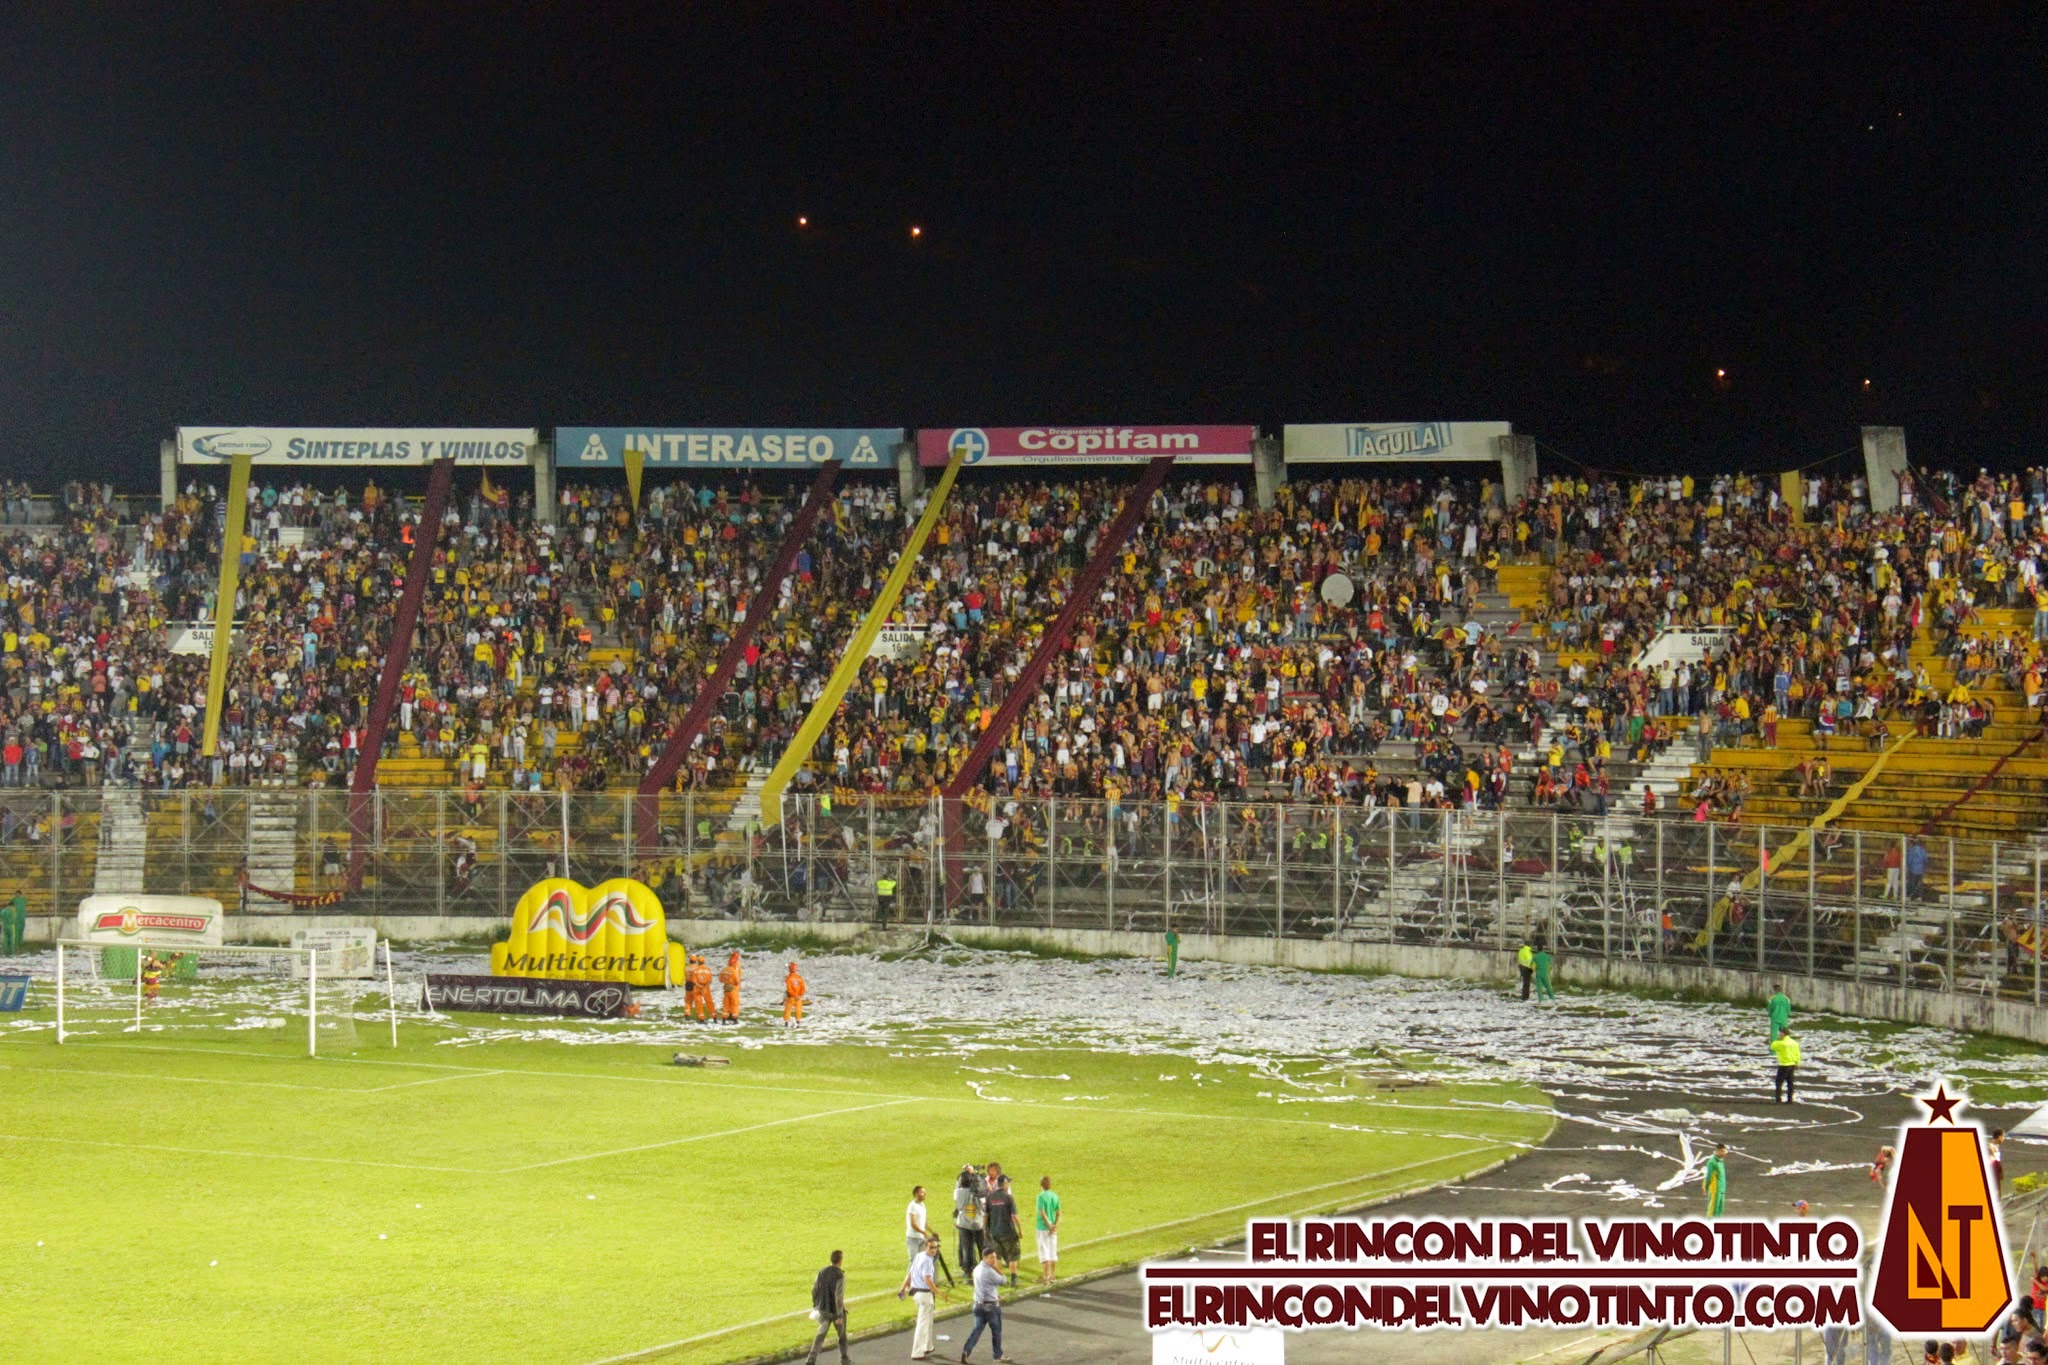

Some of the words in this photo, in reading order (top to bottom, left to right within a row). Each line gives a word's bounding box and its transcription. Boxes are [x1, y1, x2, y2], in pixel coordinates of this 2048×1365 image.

[286, 437, 410, 459] SINTEPLAS
[421, 441, 434, 458] Y
[440, 441, 525, 459] VINILOS
[624, 434, 834, 462] INTERASEO
[1018, 428, 1199, 454] Copifam
[1362, 427, 1437, 456] AGUILA
[882, 633, 915, 642] SALIDA
[892, 643, 902, 652] 16
[1691, 636, 1724, 646] SALIDA
[122, 913, 203, 929] Mercacentro
[503, 951, 667, 972] Multicentro
[428, 986, 580, 1008] ENERTOLIMA
